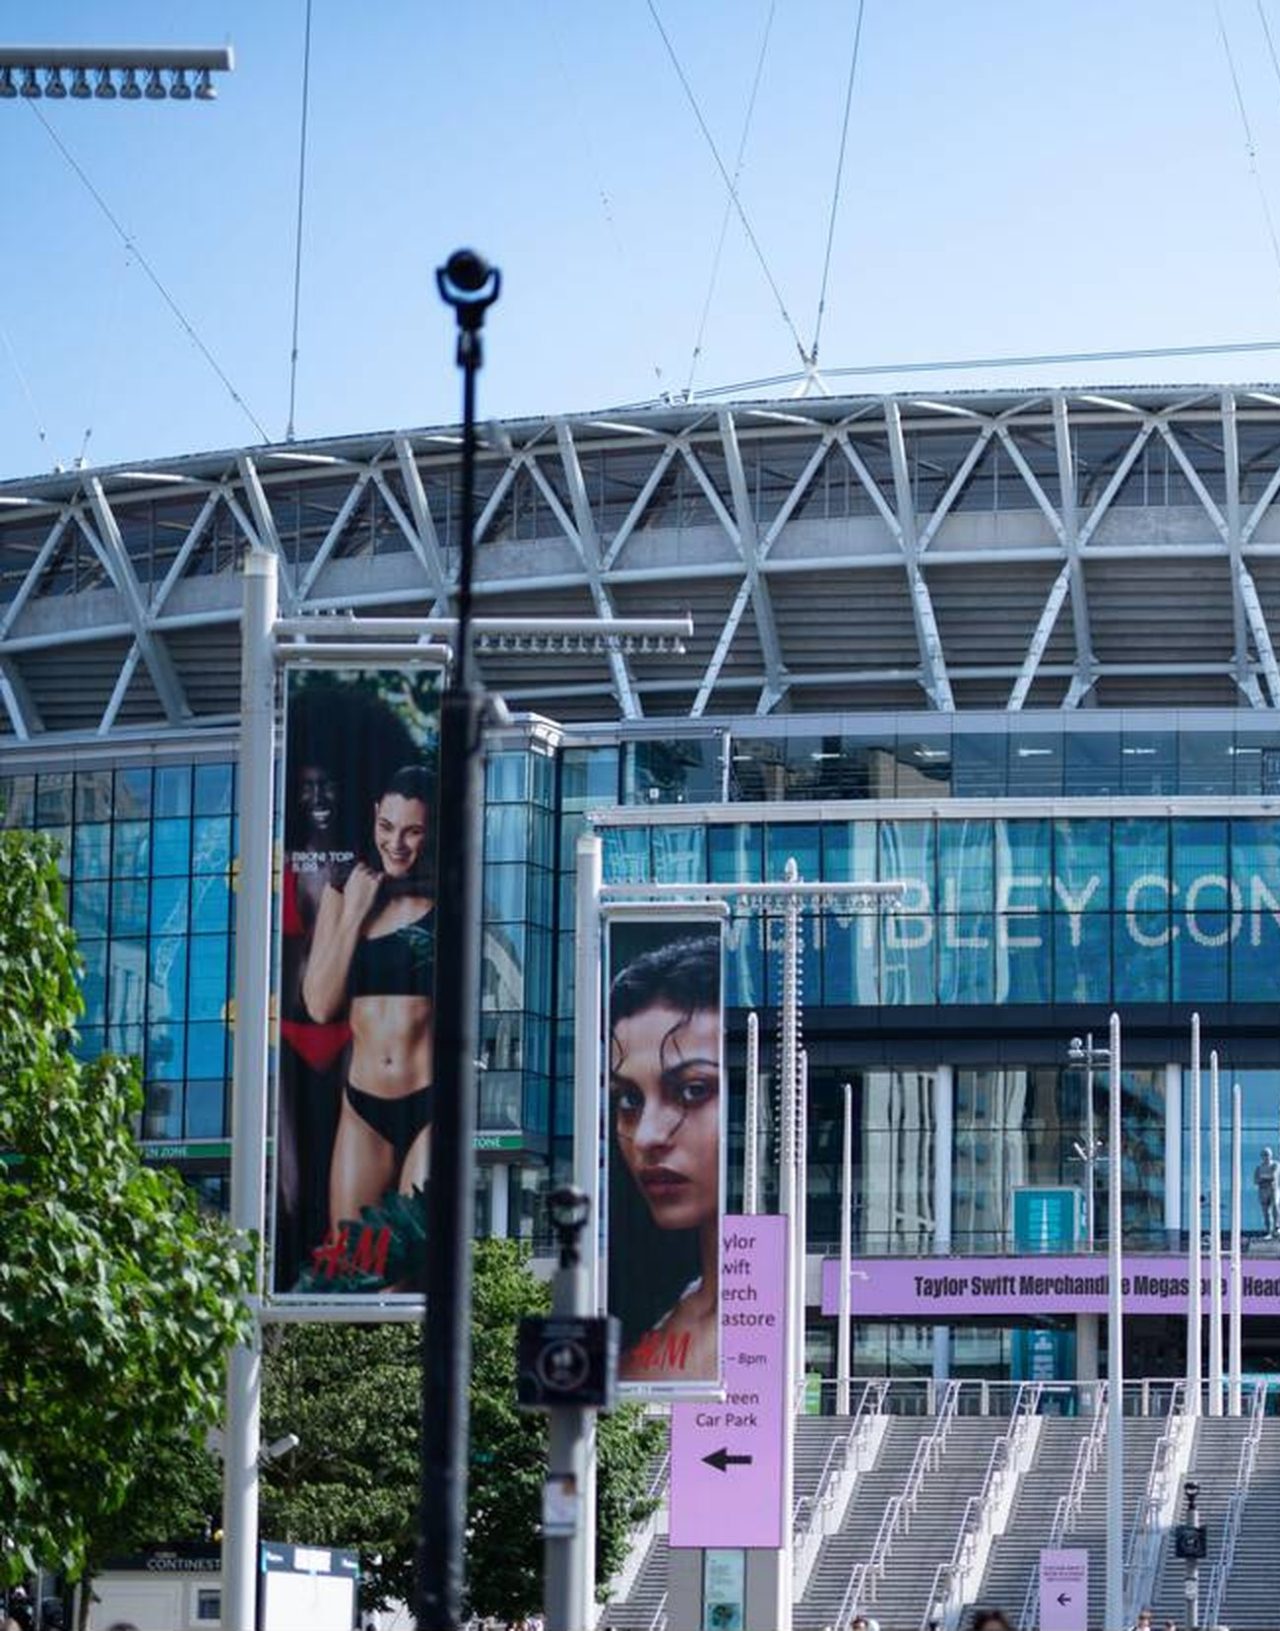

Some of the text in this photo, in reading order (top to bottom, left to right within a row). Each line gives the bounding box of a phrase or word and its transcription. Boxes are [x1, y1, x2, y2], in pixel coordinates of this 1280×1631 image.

[329, 851, 354, 862] TOP
[723, 876, 1100, 948] EMBLEY
[724, 1234, 757, 1253] ylor
[722, 1284, 757, 1301] erch
[914, 1276, 968, 1298] Taylor
[971, 1276, 1016, 1296] Swift
[1019, 1275, 1130, 1296] Merchandie
[722, 1312, 776, 1328] astore
[738, 1353, 767, 1366] 8pm
[722, 1392, 759, 1405] reen
[696, 1412, 758, 1427] Car Park
